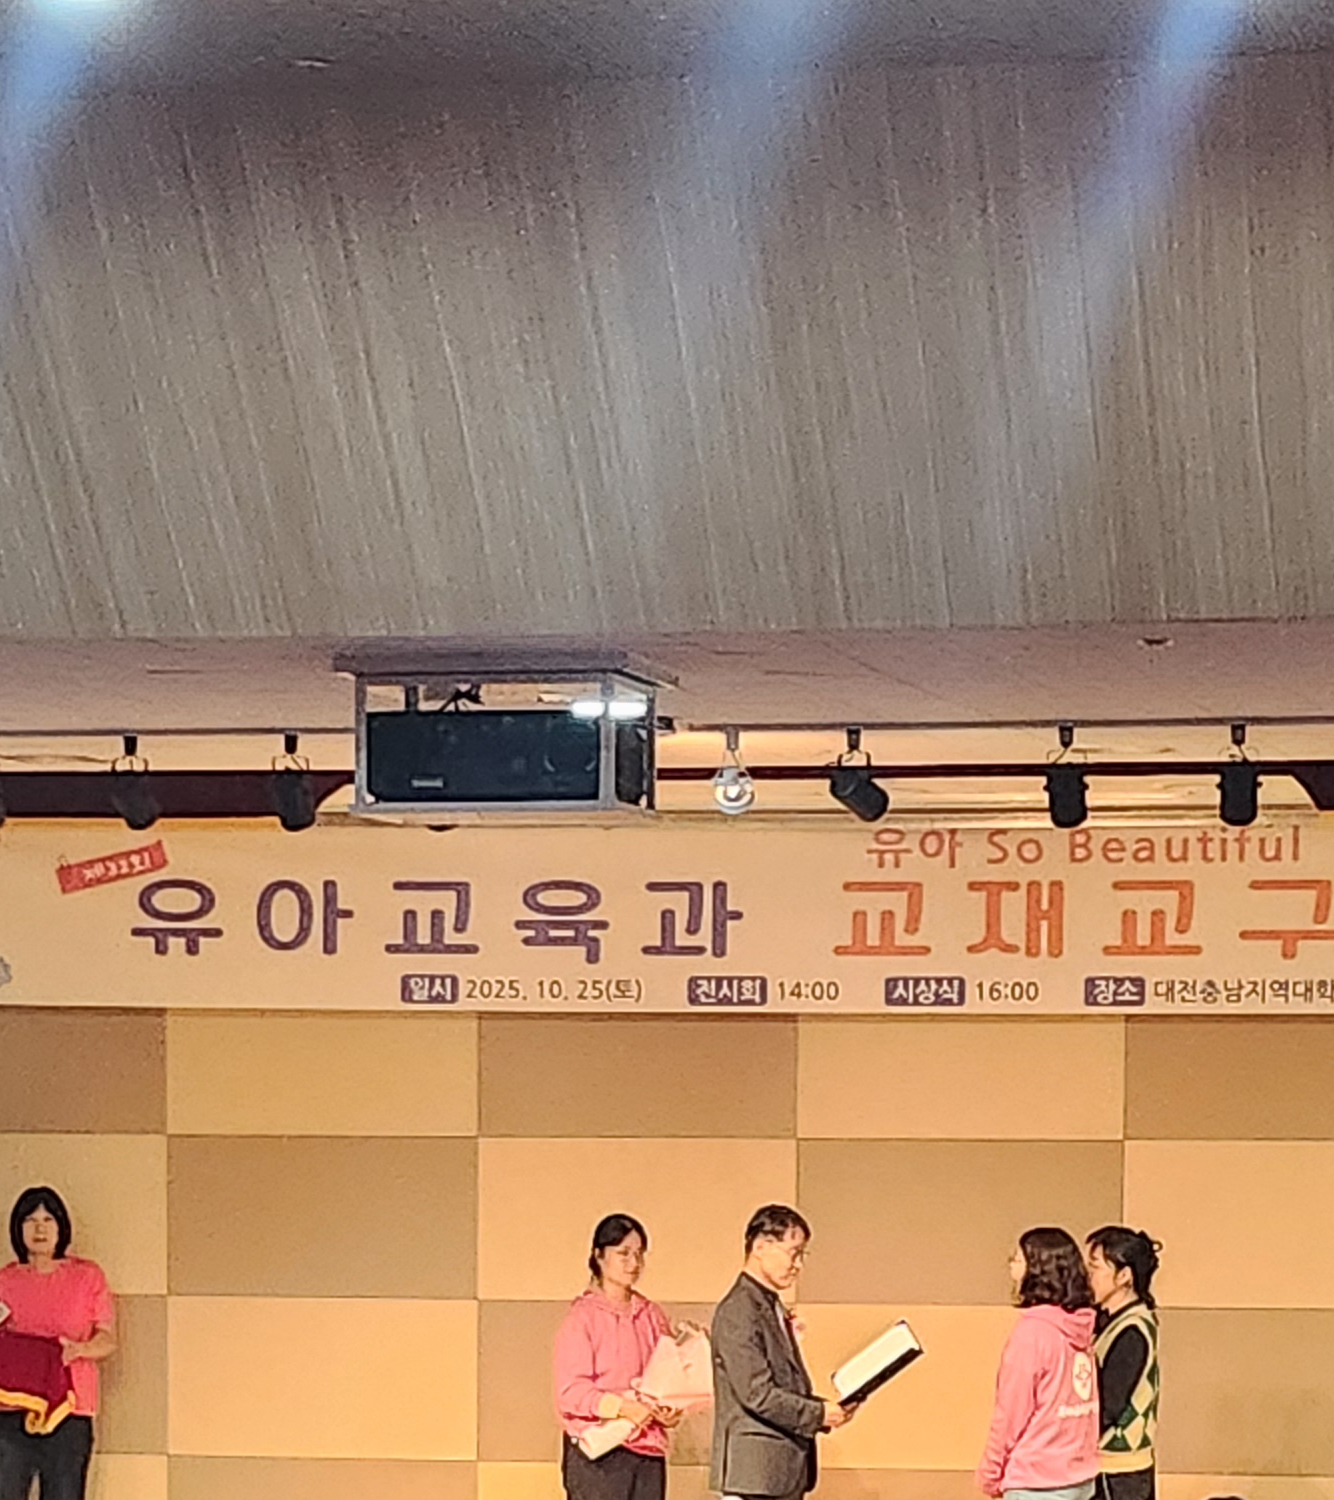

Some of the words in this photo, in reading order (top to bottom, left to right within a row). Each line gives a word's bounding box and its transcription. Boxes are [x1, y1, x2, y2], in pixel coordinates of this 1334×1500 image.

[867, 828, 964, 869] 유아
[986, 830, 1044, 864] So
[1069, 825, 1301, 864] Beautiful
[130, 878, 745, 965] 유아교육과
[408, 977, 454, 1002] 일시
[466, 979, 529, 1001] 2025.
[537, 979, 569, 1001] 10.
[576, 978, 643, 1003] 25(토)
[777, 980, 841, 1001] 14:00
[891, 980, 960, 1005] 시상식
[975, 981, 1040, 1002] 16:00
[1093, 979, 1142, 1004] 장소
